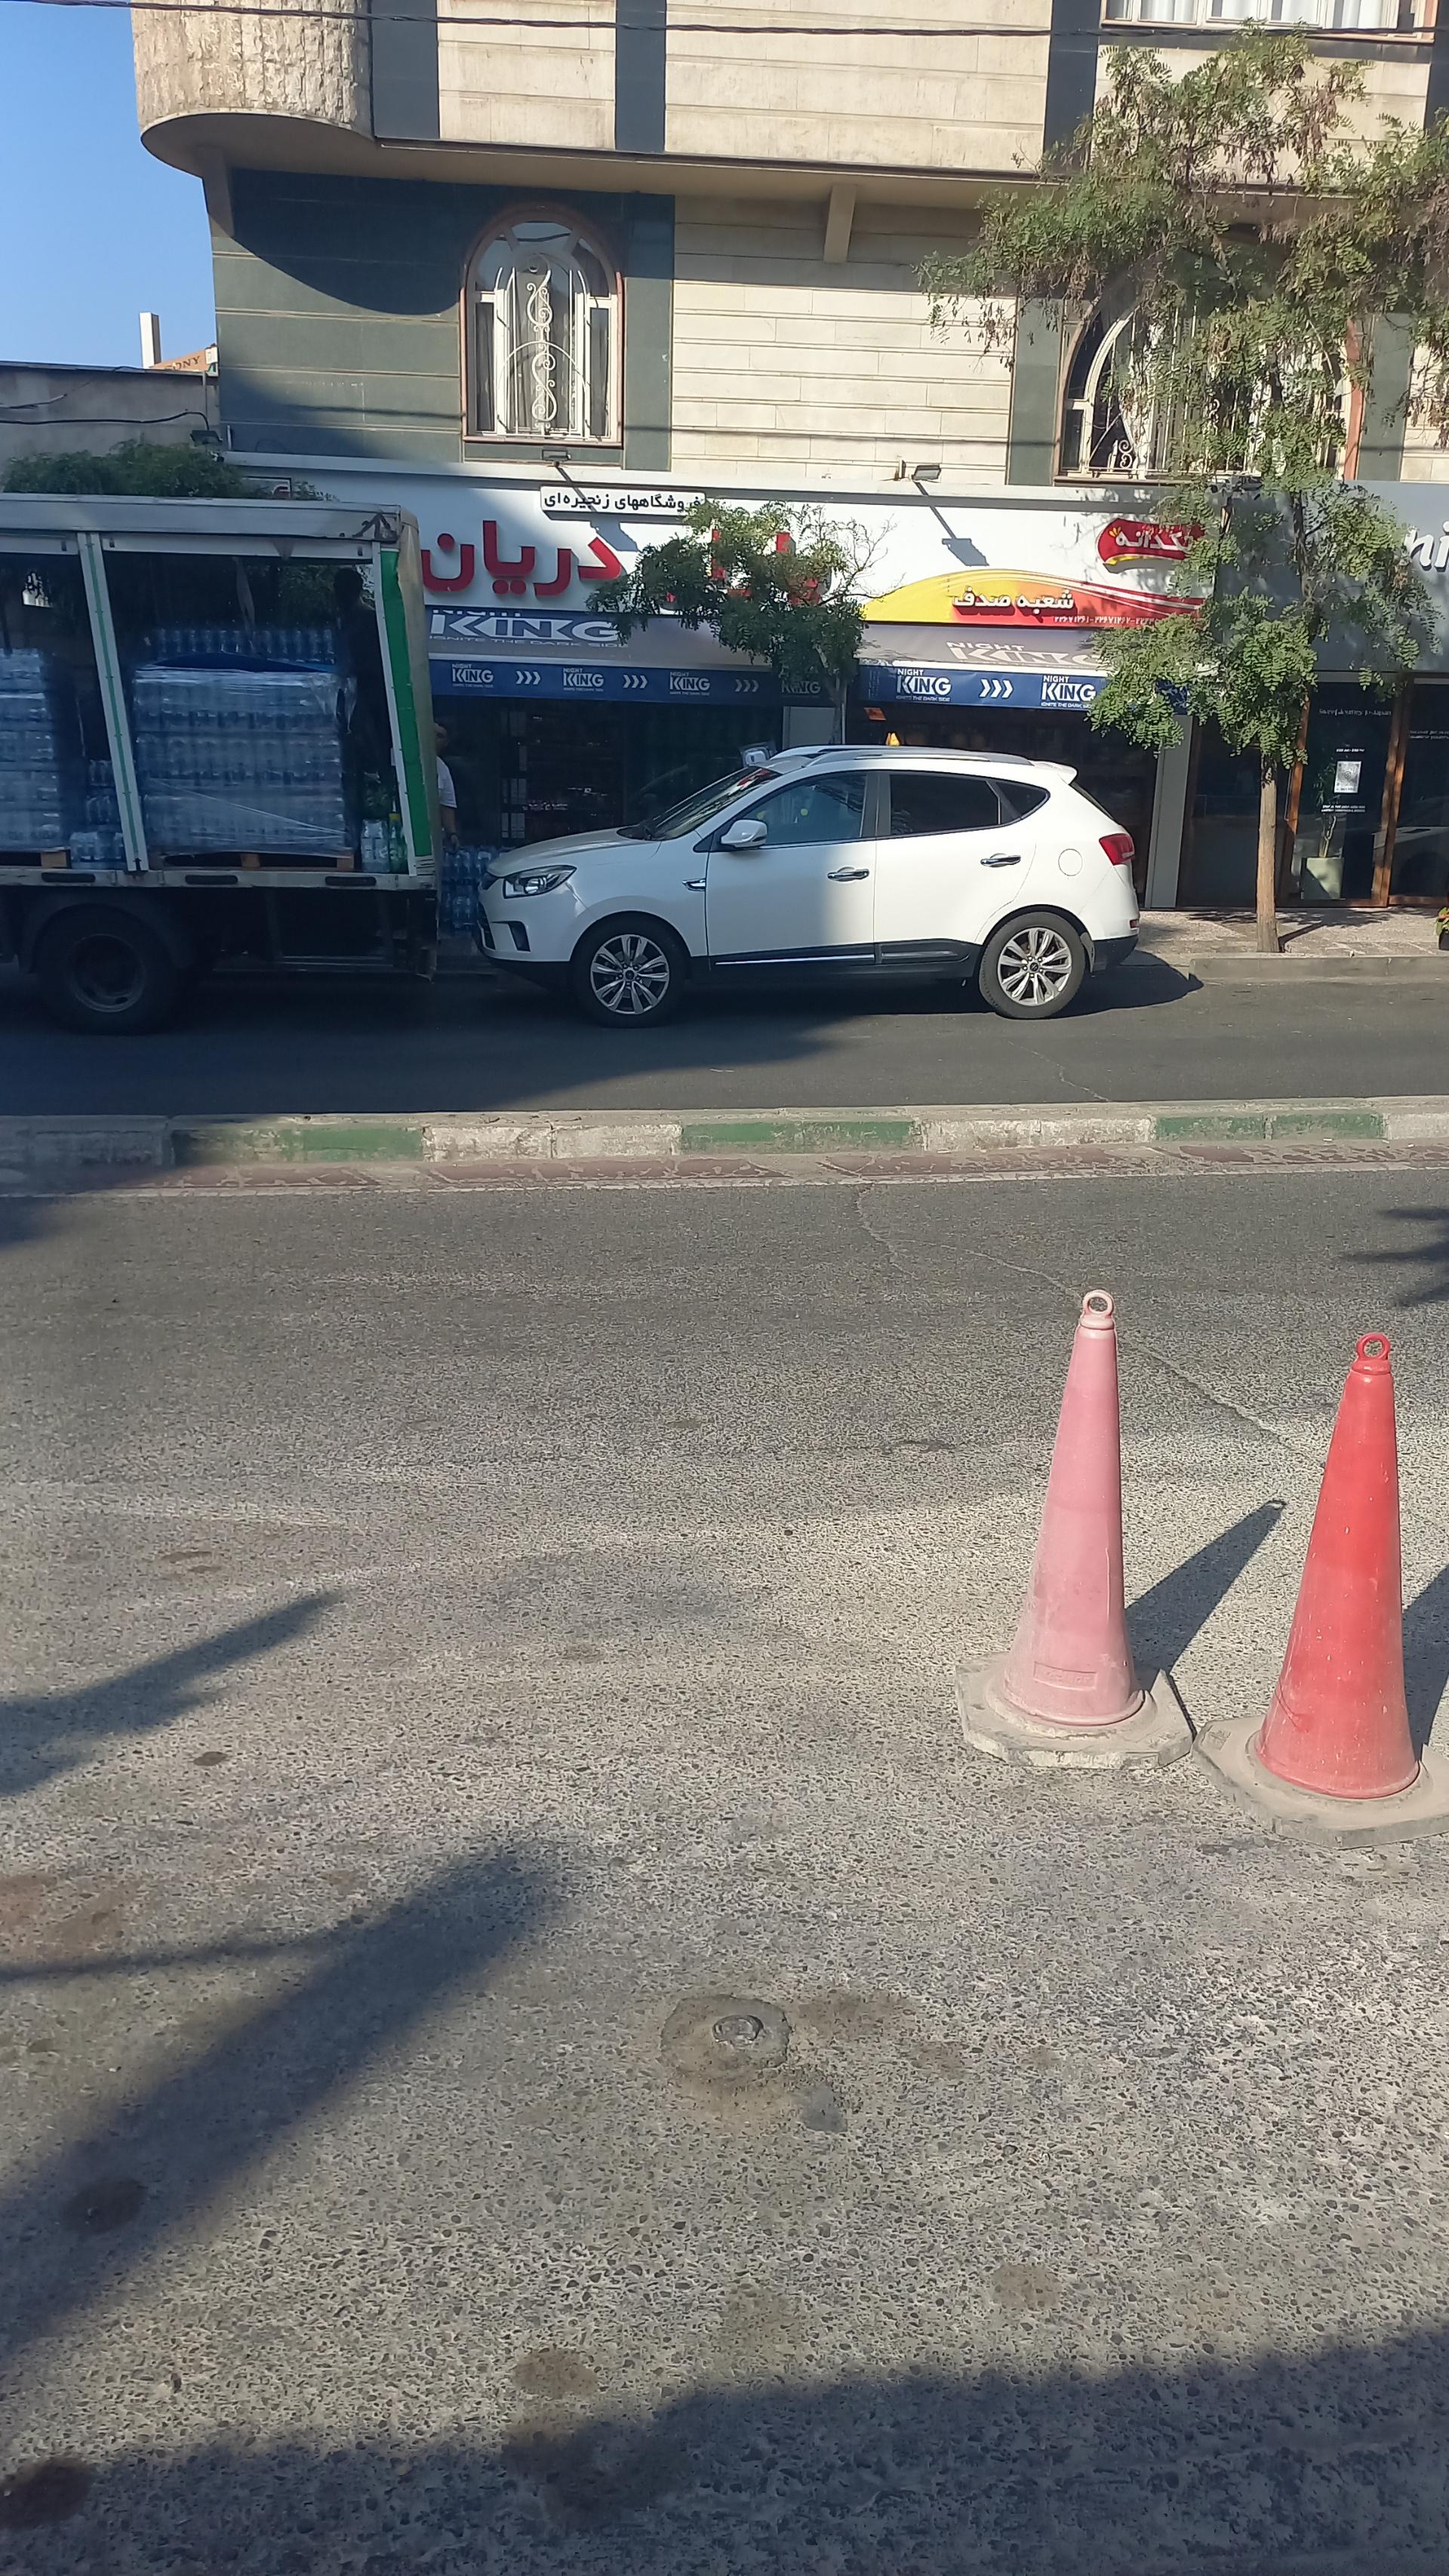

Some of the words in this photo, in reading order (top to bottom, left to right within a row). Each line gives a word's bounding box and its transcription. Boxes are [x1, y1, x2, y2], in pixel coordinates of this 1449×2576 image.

[953, 586, 1012, 607] صدف
[1017, 589, 1074, 614] شعبه
[430, 614, 621, 642] KING
[946, 642, 1025, 651] NIGHT
[452, 669, 494, 683] KING
[563, 672, 604, 688] KING
[897, 668, 924, 676] NIGHT
[1043, 675, 1069, 683] NIGHT
[669, 676, 711, 691] KING
[897, 676, 952, 696] KING
[1041, 682, 1097, 702] KING
